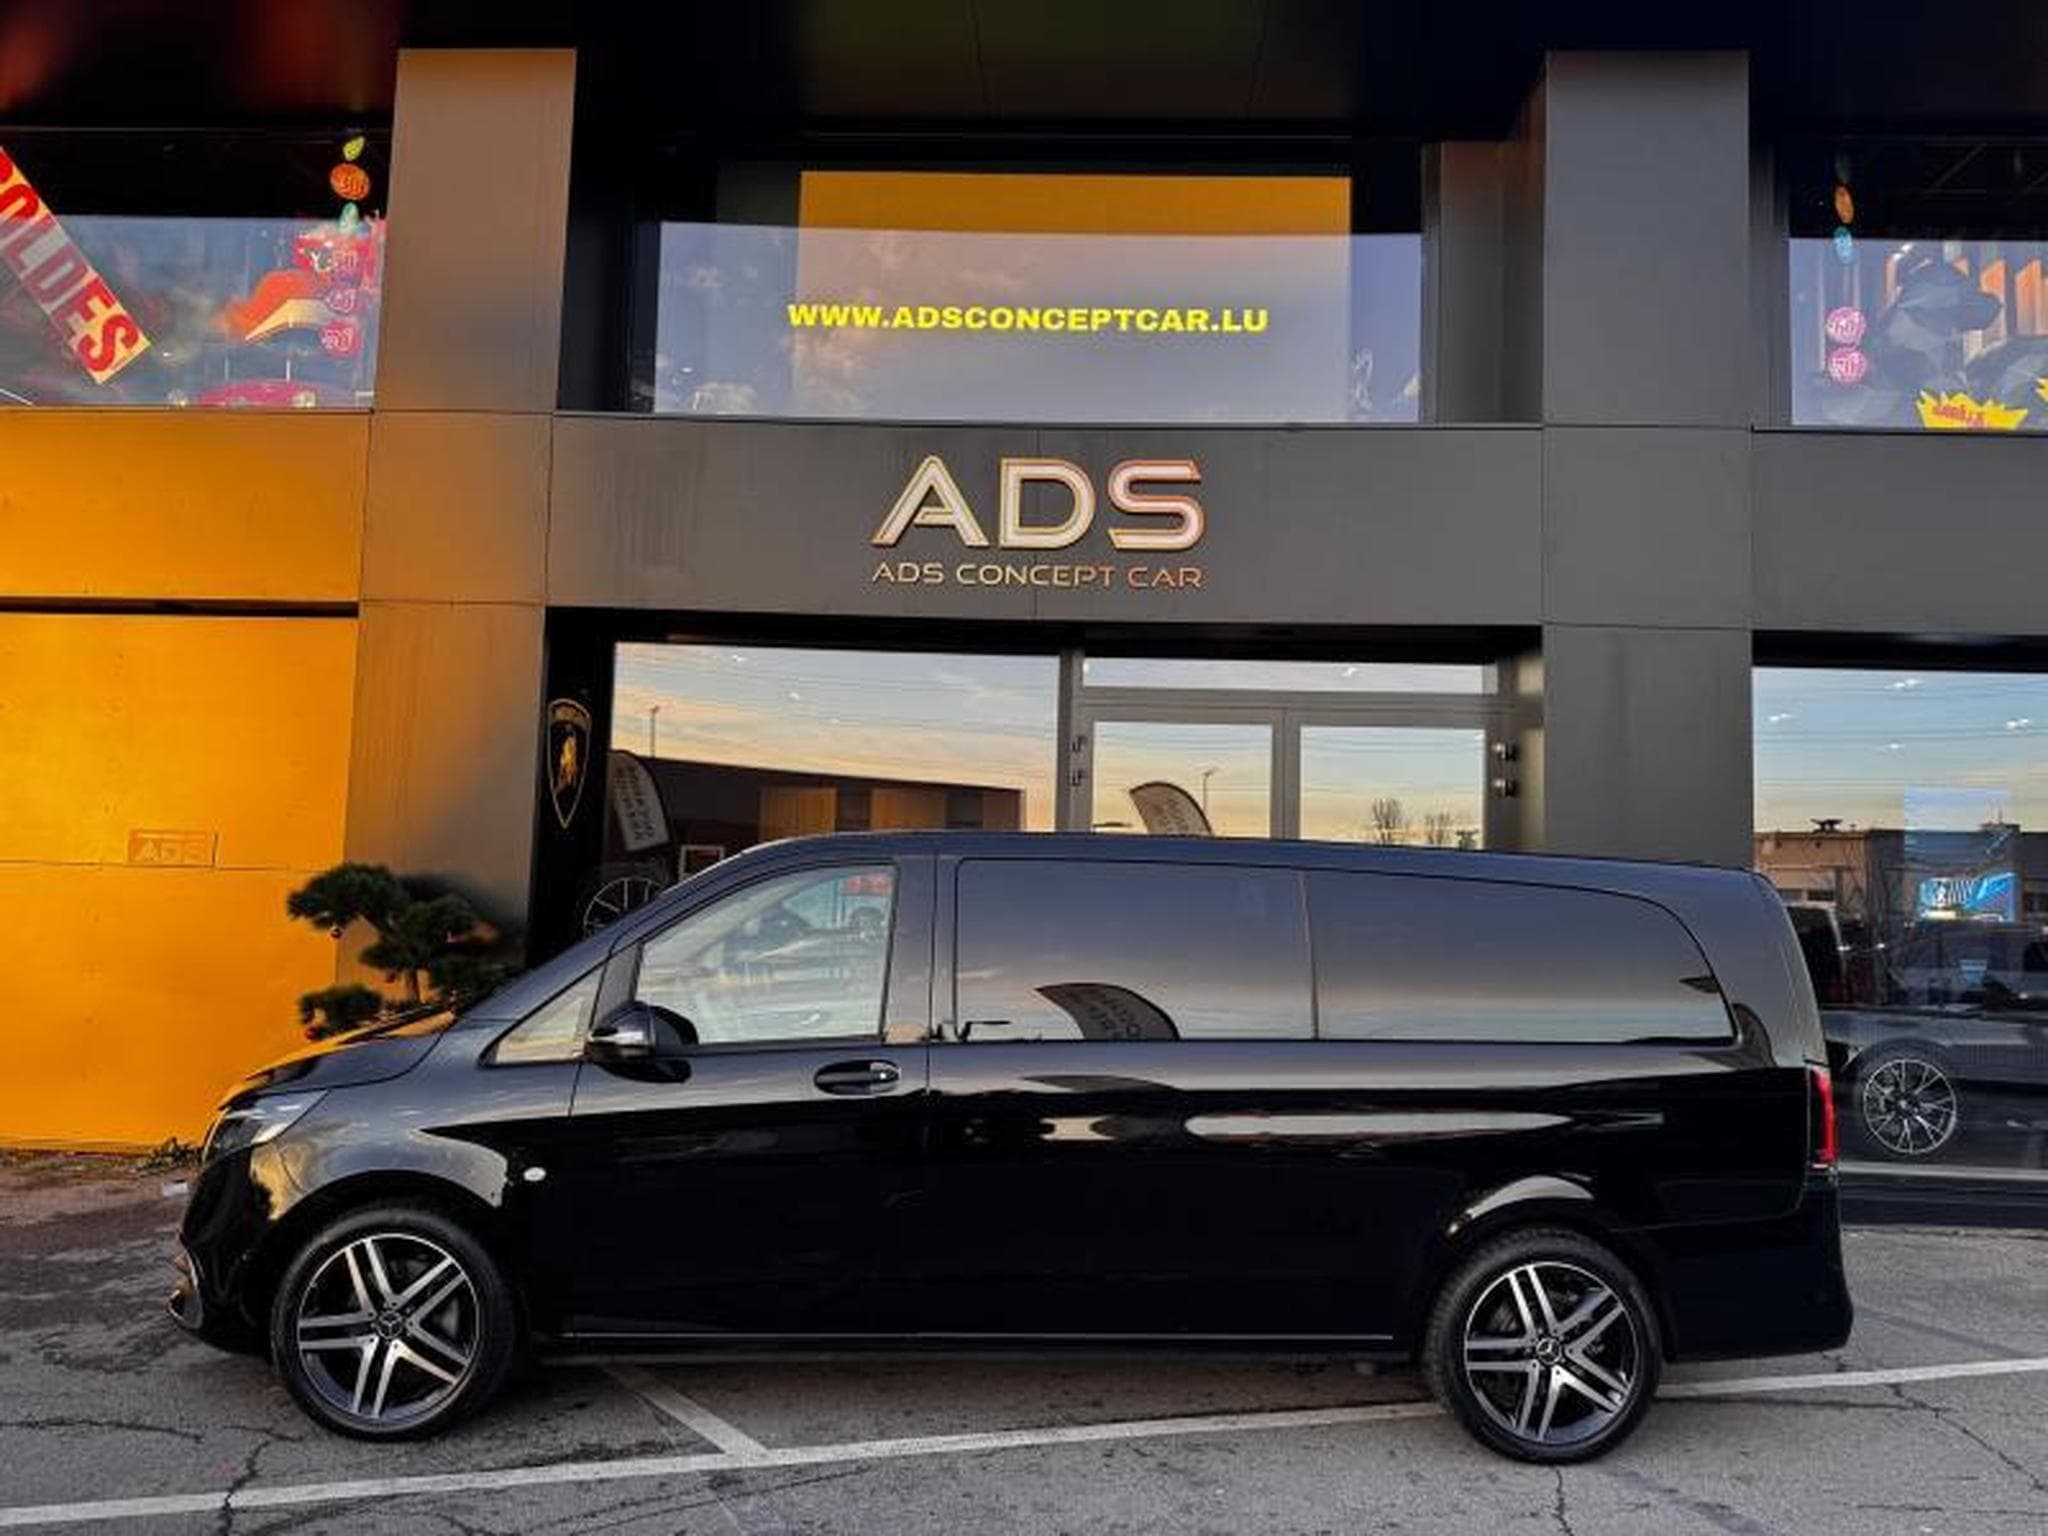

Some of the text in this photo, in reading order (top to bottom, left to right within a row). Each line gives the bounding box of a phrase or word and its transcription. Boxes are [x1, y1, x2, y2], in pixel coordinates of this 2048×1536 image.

[787, 303, 1270, 334] WWW.ADSCONCEPTCAR.LU
[870, 454, 1208, 551] ADS
[871, 562, 1207, 590] ADS CONCEPT CAR
